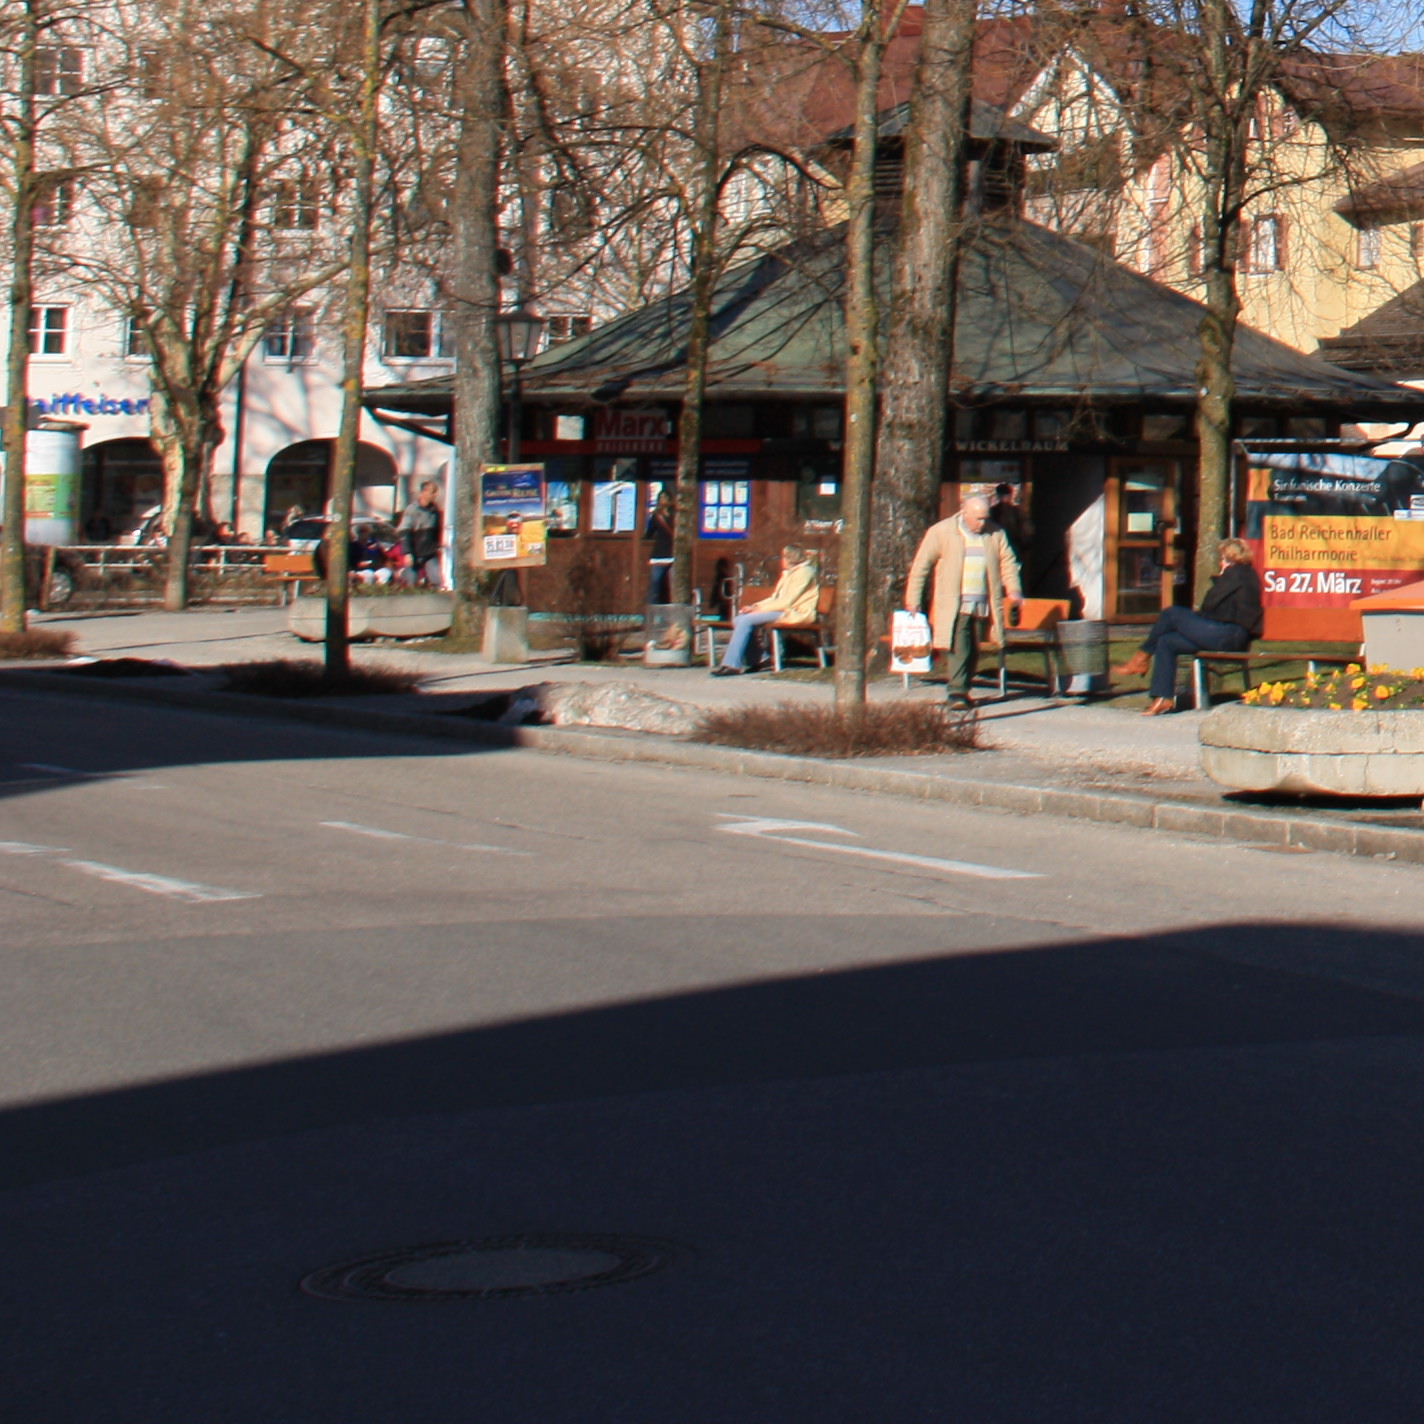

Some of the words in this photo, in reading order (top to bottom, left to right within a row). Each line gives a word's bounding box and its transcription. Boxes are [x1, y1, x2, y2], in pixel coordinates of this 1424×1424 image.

[596, 409, 664, 437] Marx
[1335, 479, 1382, 493] Konzerte
[1271, 525, 1295, 541] Bad
[1299, 525, 1393, 541] Reichenhaller
[1270, 546, 1358, 561] Philharmonie
[1264, 571, 1287, 593] Sa
[1290, 573, 1314, 593] 27.
[1317, 572, 1362, 594] März
